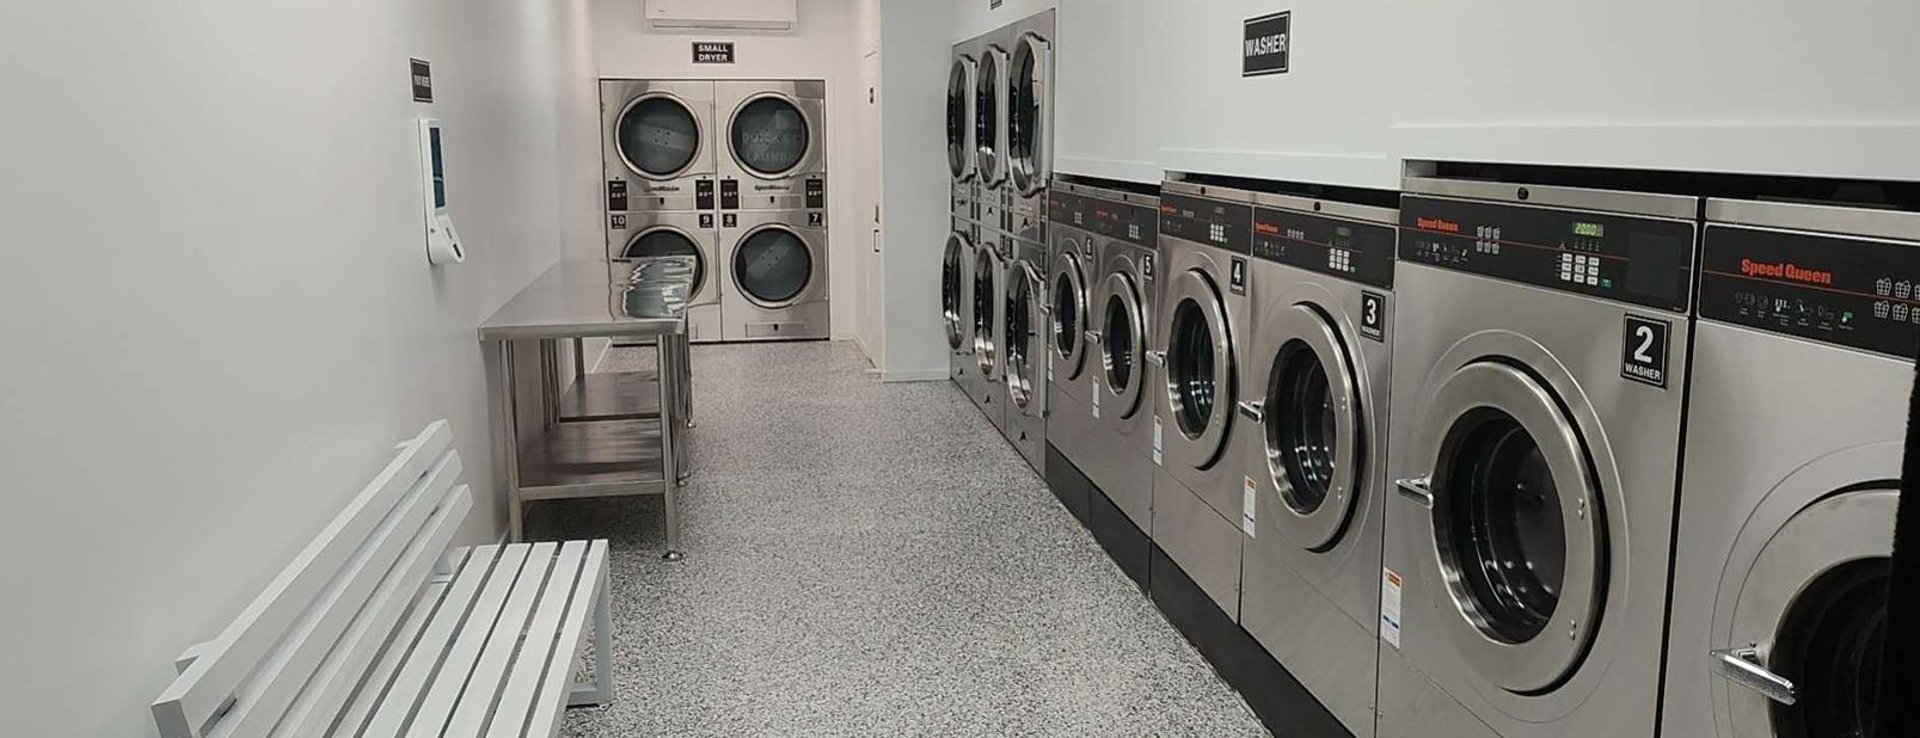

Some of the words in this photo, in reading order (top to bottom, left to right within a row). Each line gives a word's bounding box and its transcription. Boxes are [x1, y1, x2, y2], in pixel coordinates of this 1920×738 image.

[698, 44, 728, 52] SMALL
[1245, 33, 1286, 57] WASHER
[698, 53, 728, 61] DRYER
[612, 216, 625, 225] 10
[703, 215, 710, 224] 9
[726, 215, 733, 224] 8
[811, 213, 819, 222] 7
[1417, 217, 1437, 230] Speed
[1437, 219, 1459, 232] Queen
[1145, 255, 1152, 274] 5
[1233, 262, 1242, 283] 4
[1741, 258, 1784, 277] Speed
[1785, 263, 1832, 284] Queen
[1366, 299, 1377, 325] 3
[1634, 325, 1654, 364] 2
[1625, 362, 1661, 381] WASHER
